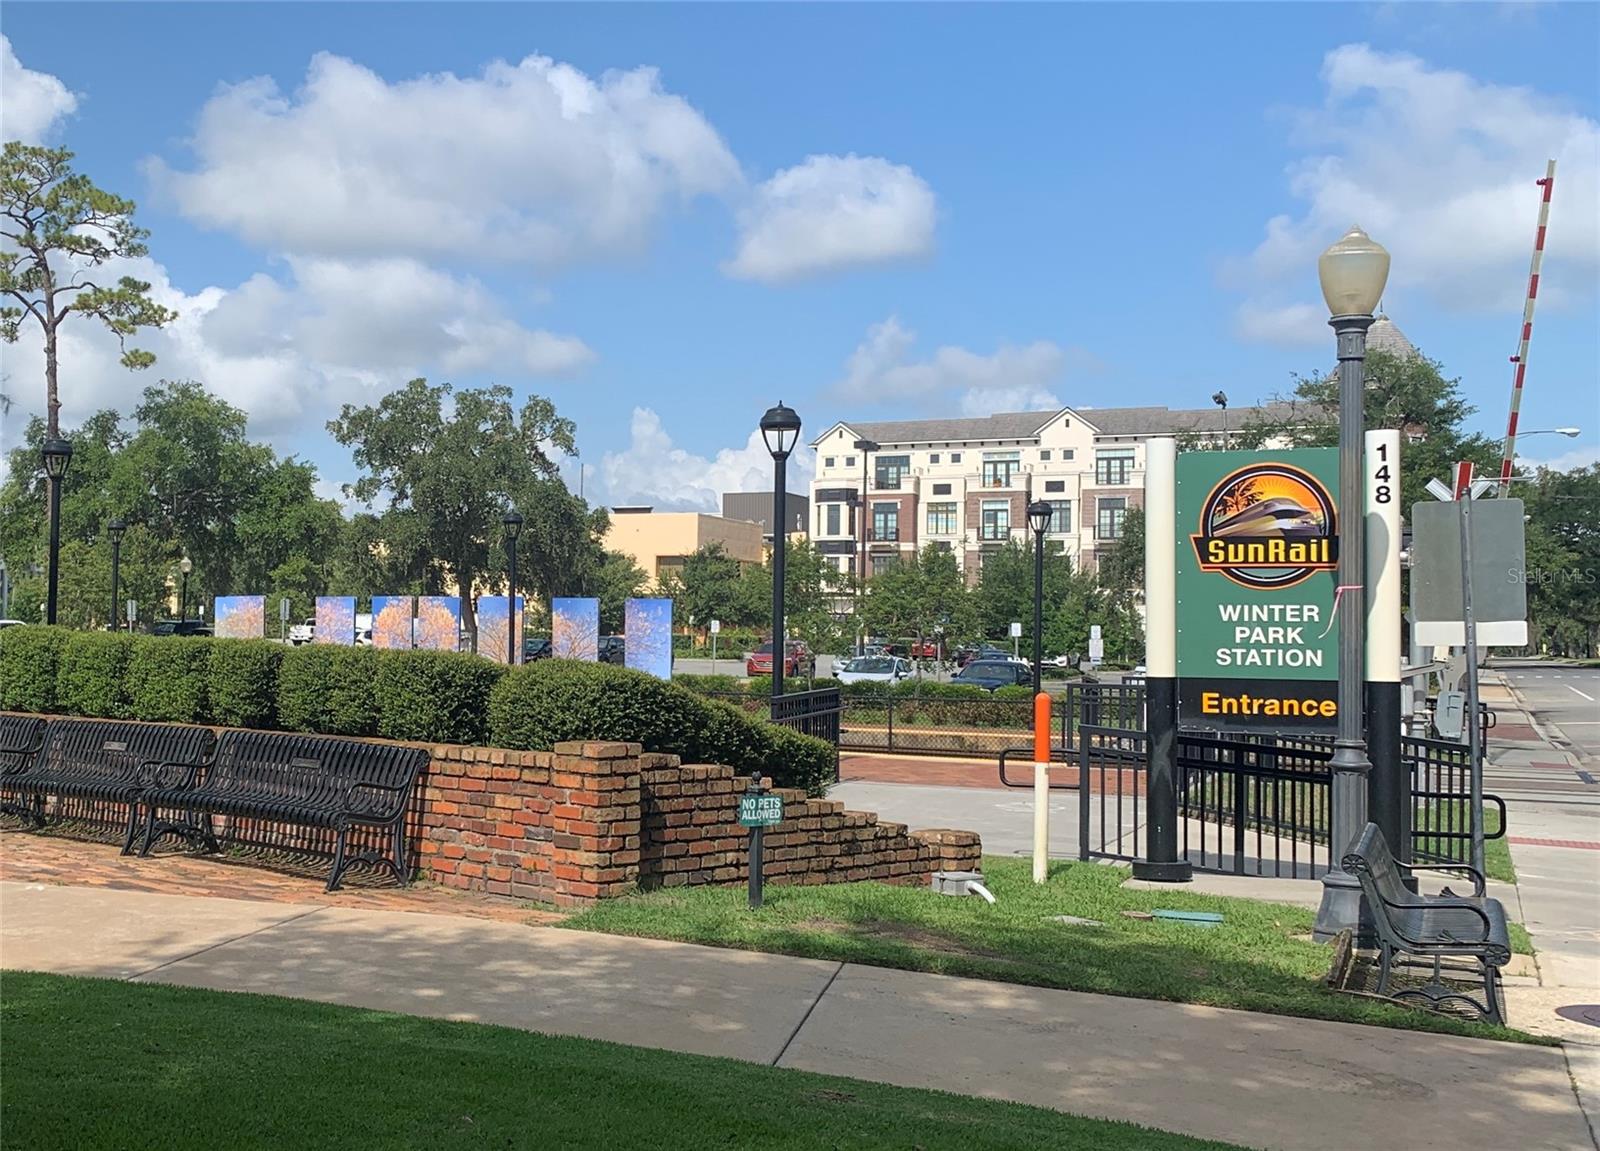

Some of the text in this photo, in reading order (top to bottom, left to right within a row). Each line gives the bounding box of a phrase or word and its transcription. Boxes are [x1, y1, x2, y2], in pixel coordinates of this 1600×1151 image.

[1375, 444, 1391, 504] 148
[1208, 539, 1329, 563] SunRail
[1219, 605, 1320, 622] WINTER
[1235, 627, 1304, 644] PARK
[1216, 649, 1322, 667] STATION
[1202, 693, 1337, 717] Entrance
[742, 798, 780, 809] NO PETS
[741, 809, 781, 820] ALLOWED
